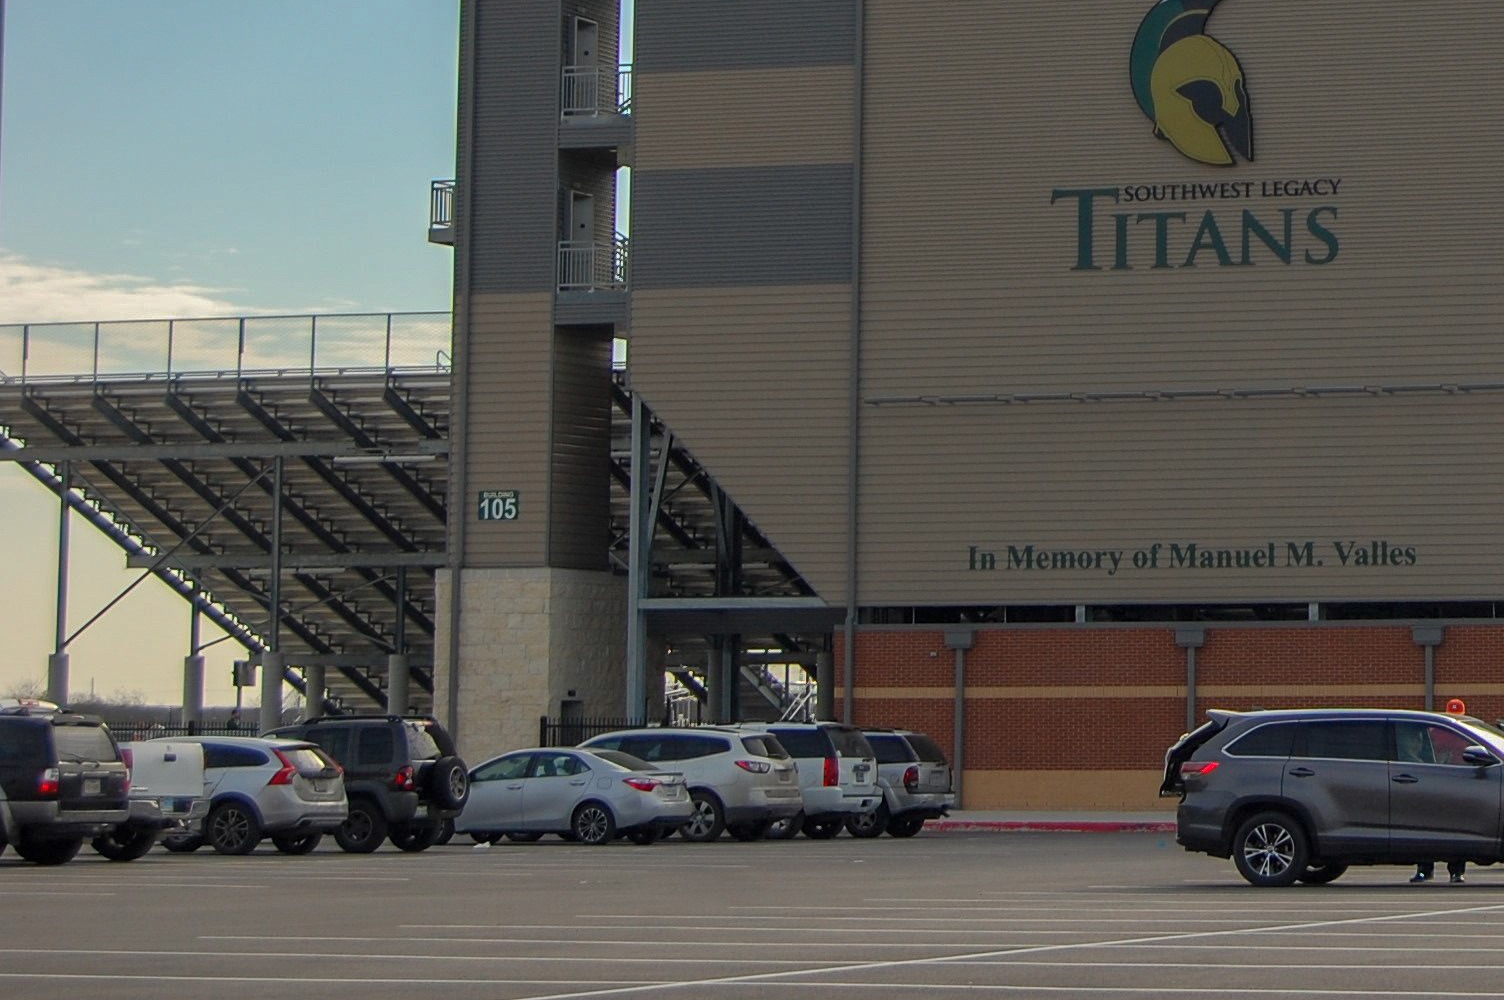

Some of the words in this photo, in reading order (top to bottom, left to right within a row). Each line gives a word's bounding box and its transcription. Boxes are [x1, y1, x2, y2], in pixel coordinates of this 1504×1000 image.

[1123, 181, 1255, 202] SOUTHWEST
[1261, 178, 1342, 198] LEGACY
[1051, 186, 1340, 271] TITANS
[480, 498, 517, 520] 105
[968, 545, 996, 571] In
[1006, 544, 1124, 576] Memory
[1132, 543, 1163, 569] of
[1168, 542, 1276, 569] Manuel
[1285, 541, 1324, 567] M.
[1333, 540, 1417, 567] Valles
